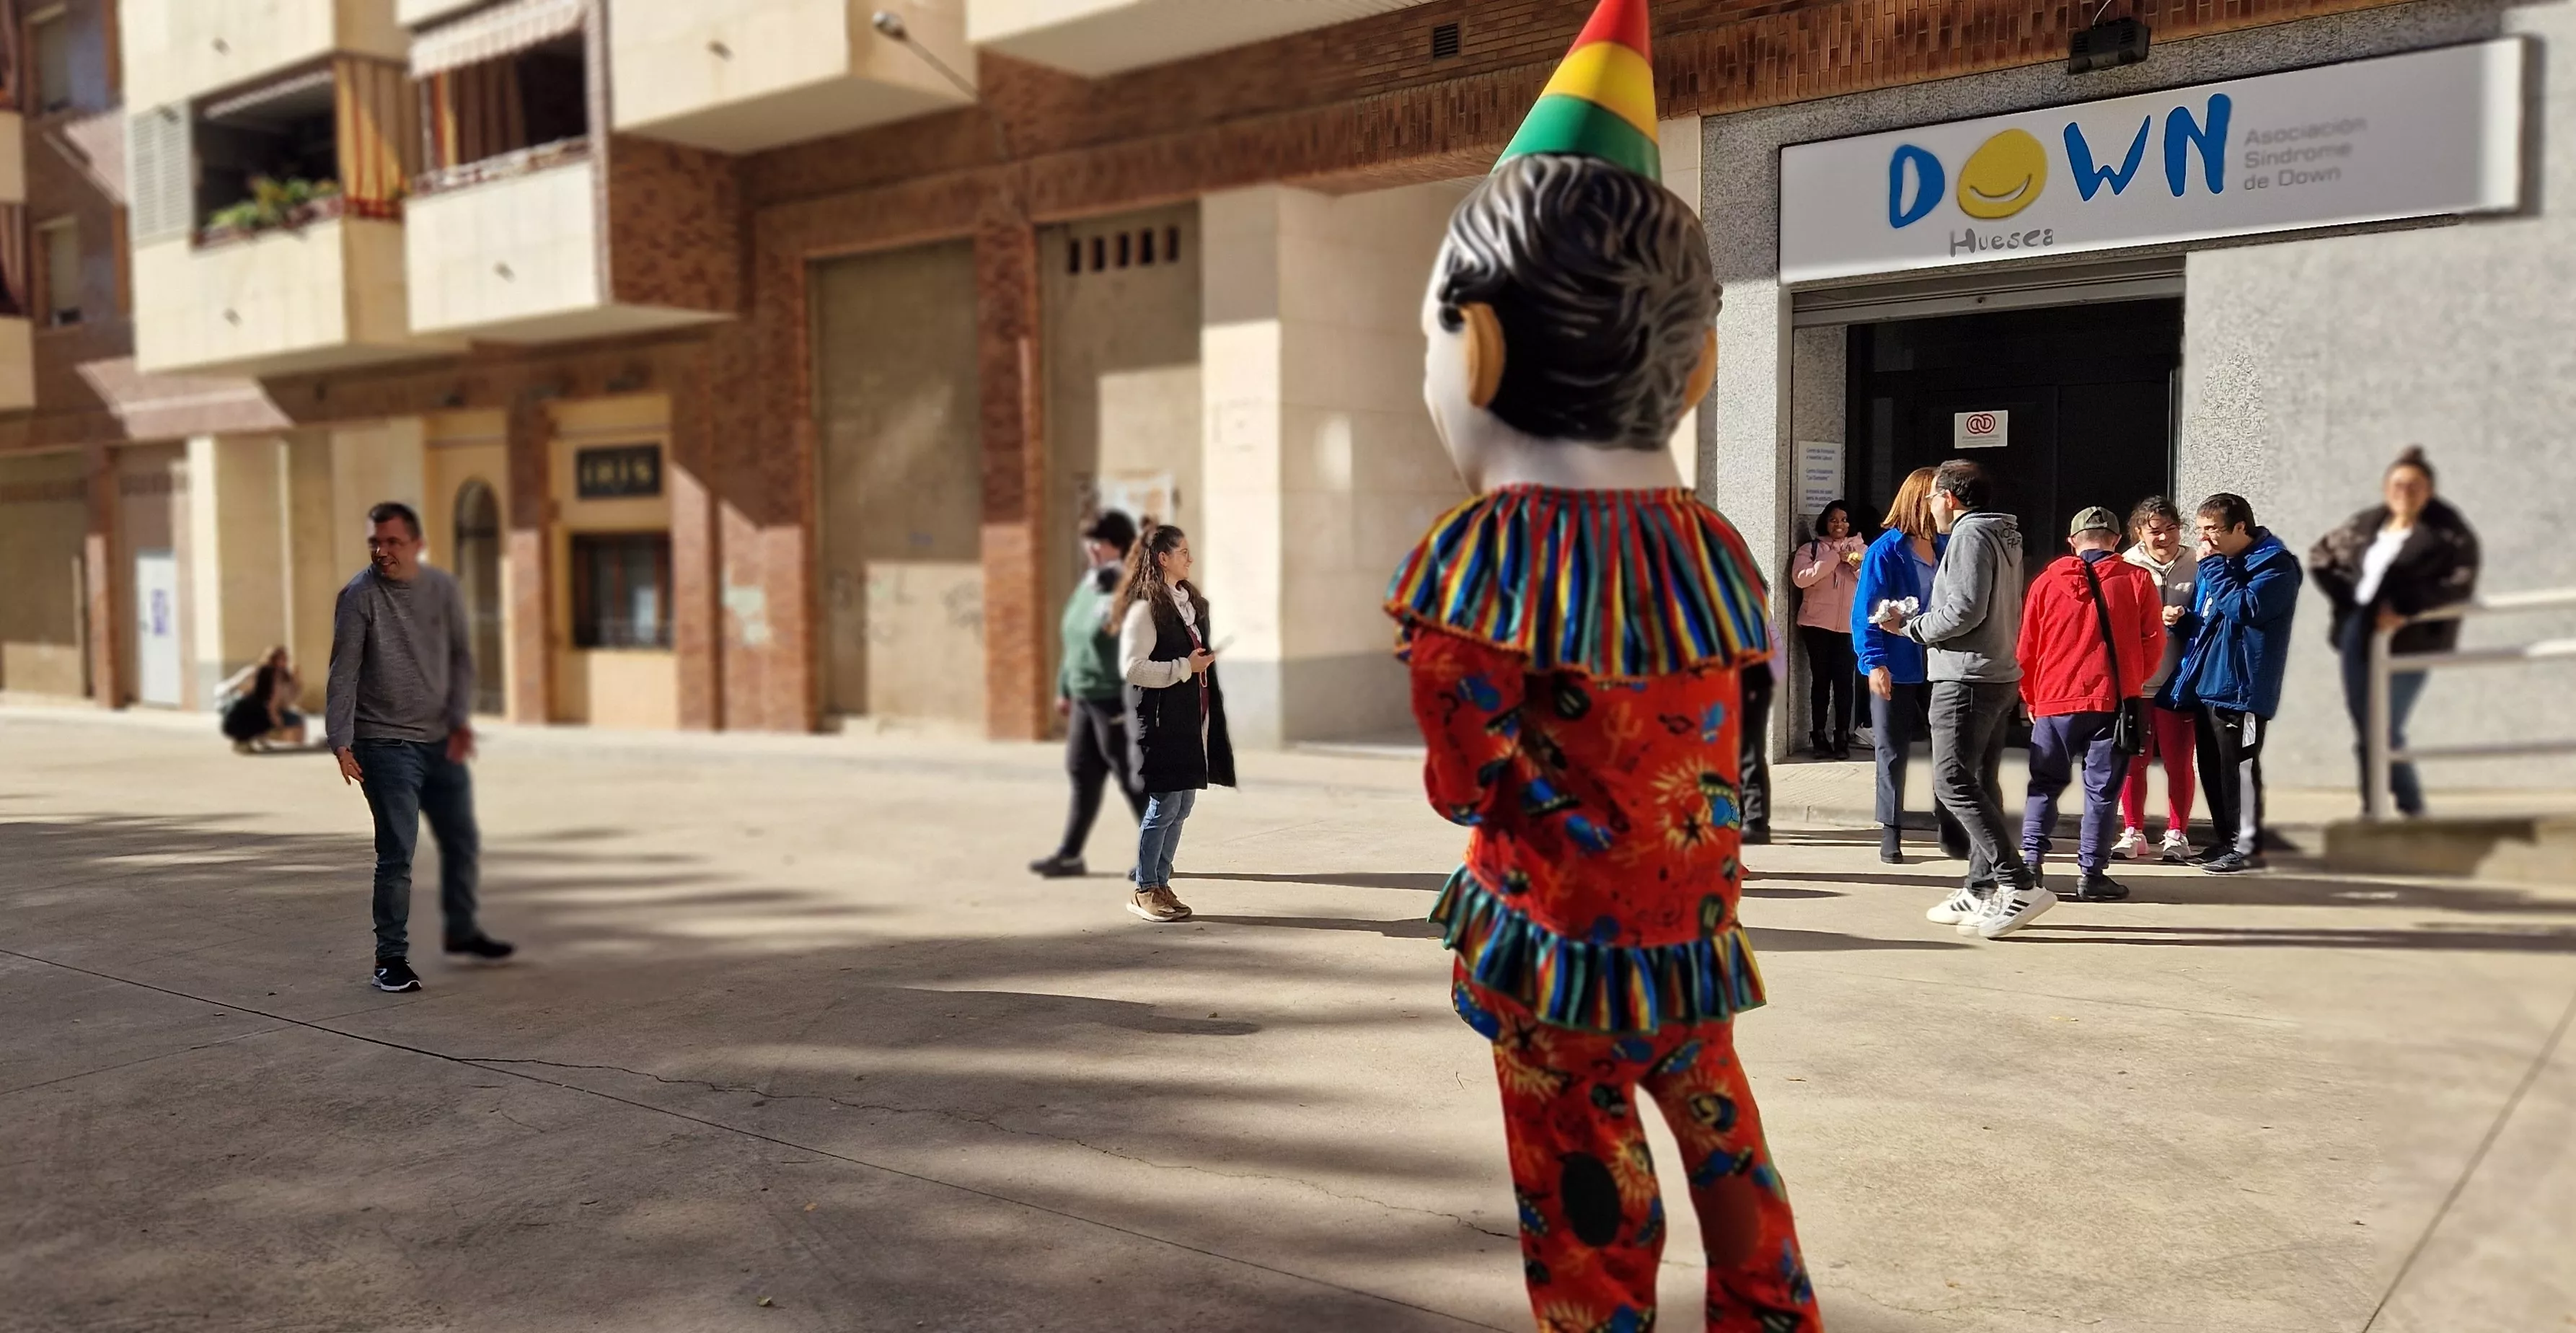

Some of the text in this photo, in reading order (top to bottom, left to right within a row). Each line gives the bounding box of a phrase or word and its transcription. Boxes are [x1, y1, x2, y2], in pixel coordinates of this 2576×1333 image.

[1889, 93, 2232, 229] DOWN
[2244, 167, 2342, 190] de Down
[1950, 228, 2054, 258] Huesca
